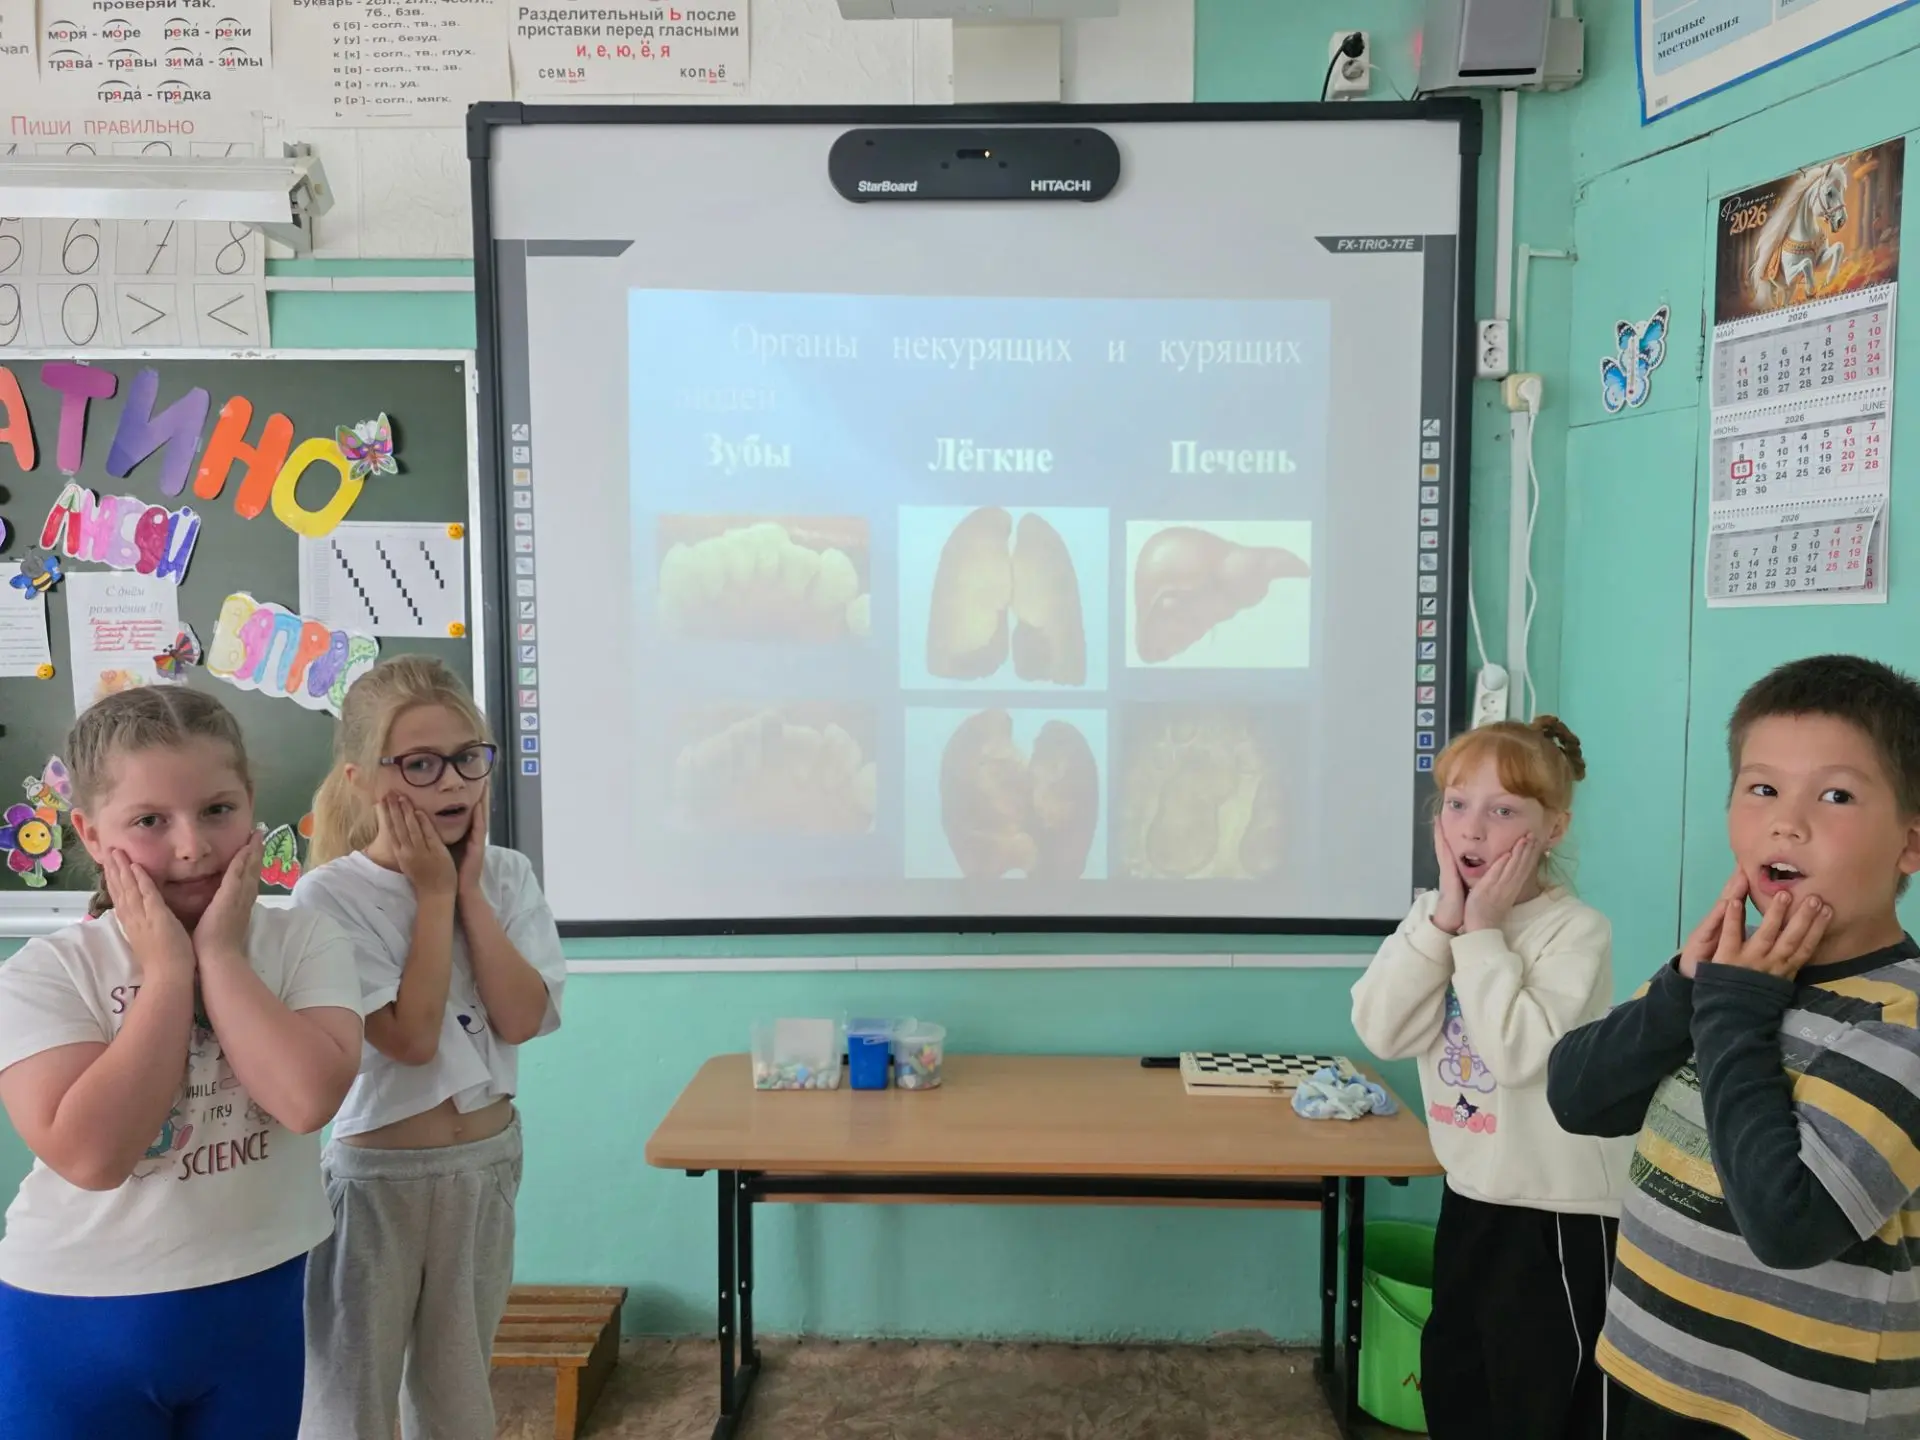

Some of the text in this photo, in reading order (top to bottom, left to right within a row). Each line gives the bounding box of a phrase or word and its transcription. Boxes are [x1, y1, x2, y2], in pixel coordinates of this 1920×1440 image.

[518, 7, 663, 22] Разделительный
[686, 9, 736, 21] после
[517, 24, 739, 39] приставки перед гласными
[1657, 15, 1705, 45] Личные
[1657, 14, 1740, 61] местоимения
[538, 65, 725, 79] семья копьё
[858, 179, 1091, 193] StarBoard HITACHI
[1730, 203, 1768, 235] 2026
[1337, 238, 1415, 250] FX-TRIO-77E
[1869, 292, 1890, 303] MAY
[1788, 311, 1808, 322] 2026
[1868, 327, 1881, 336] 10
[732, 323, 1302, 373] Органы некурящих и курящих
[1737, 340, 1881, 376] 11 12 13 14 15 16 17
[1737, 353, 1880, 388] 18 19 20 21 22 23 24
[1737, 366, 1880, 400] 25 26 27 28 29 30 31
[1860, 401, 1885, 412] JUNE
[1785, 415, 1804, 424] 2026
[705, 432, 1297, 476] Зубы Лёгкие Печень
[1776, 448, 1789, 456] 10
[1798, 444, 1809, 453] 11
[1820, 441, 1833, 450] 12
[1842, 438, 1855, 447] 13
[1866, 435, 1880, 444] 14
[1736, 448, 1879, 473] 15 16 17 18 19 20 21
[1755, 474, 1767, 482] 23
[1775, 471, 1787, 480] 24
[1795, 468, 1809, 477] 25
[1818, 465, 1831, 475] 26
[1841, 463, 1854, 472] 27
[1865, 460, 1879, 470] 28
[1735, 485, 1767, 496] 29 30
[186, 1081, 217, 1100] WHILE
[209, 1104, 233, 1120] TRY
[178, 1130, 271, 1182] SCIENCE
